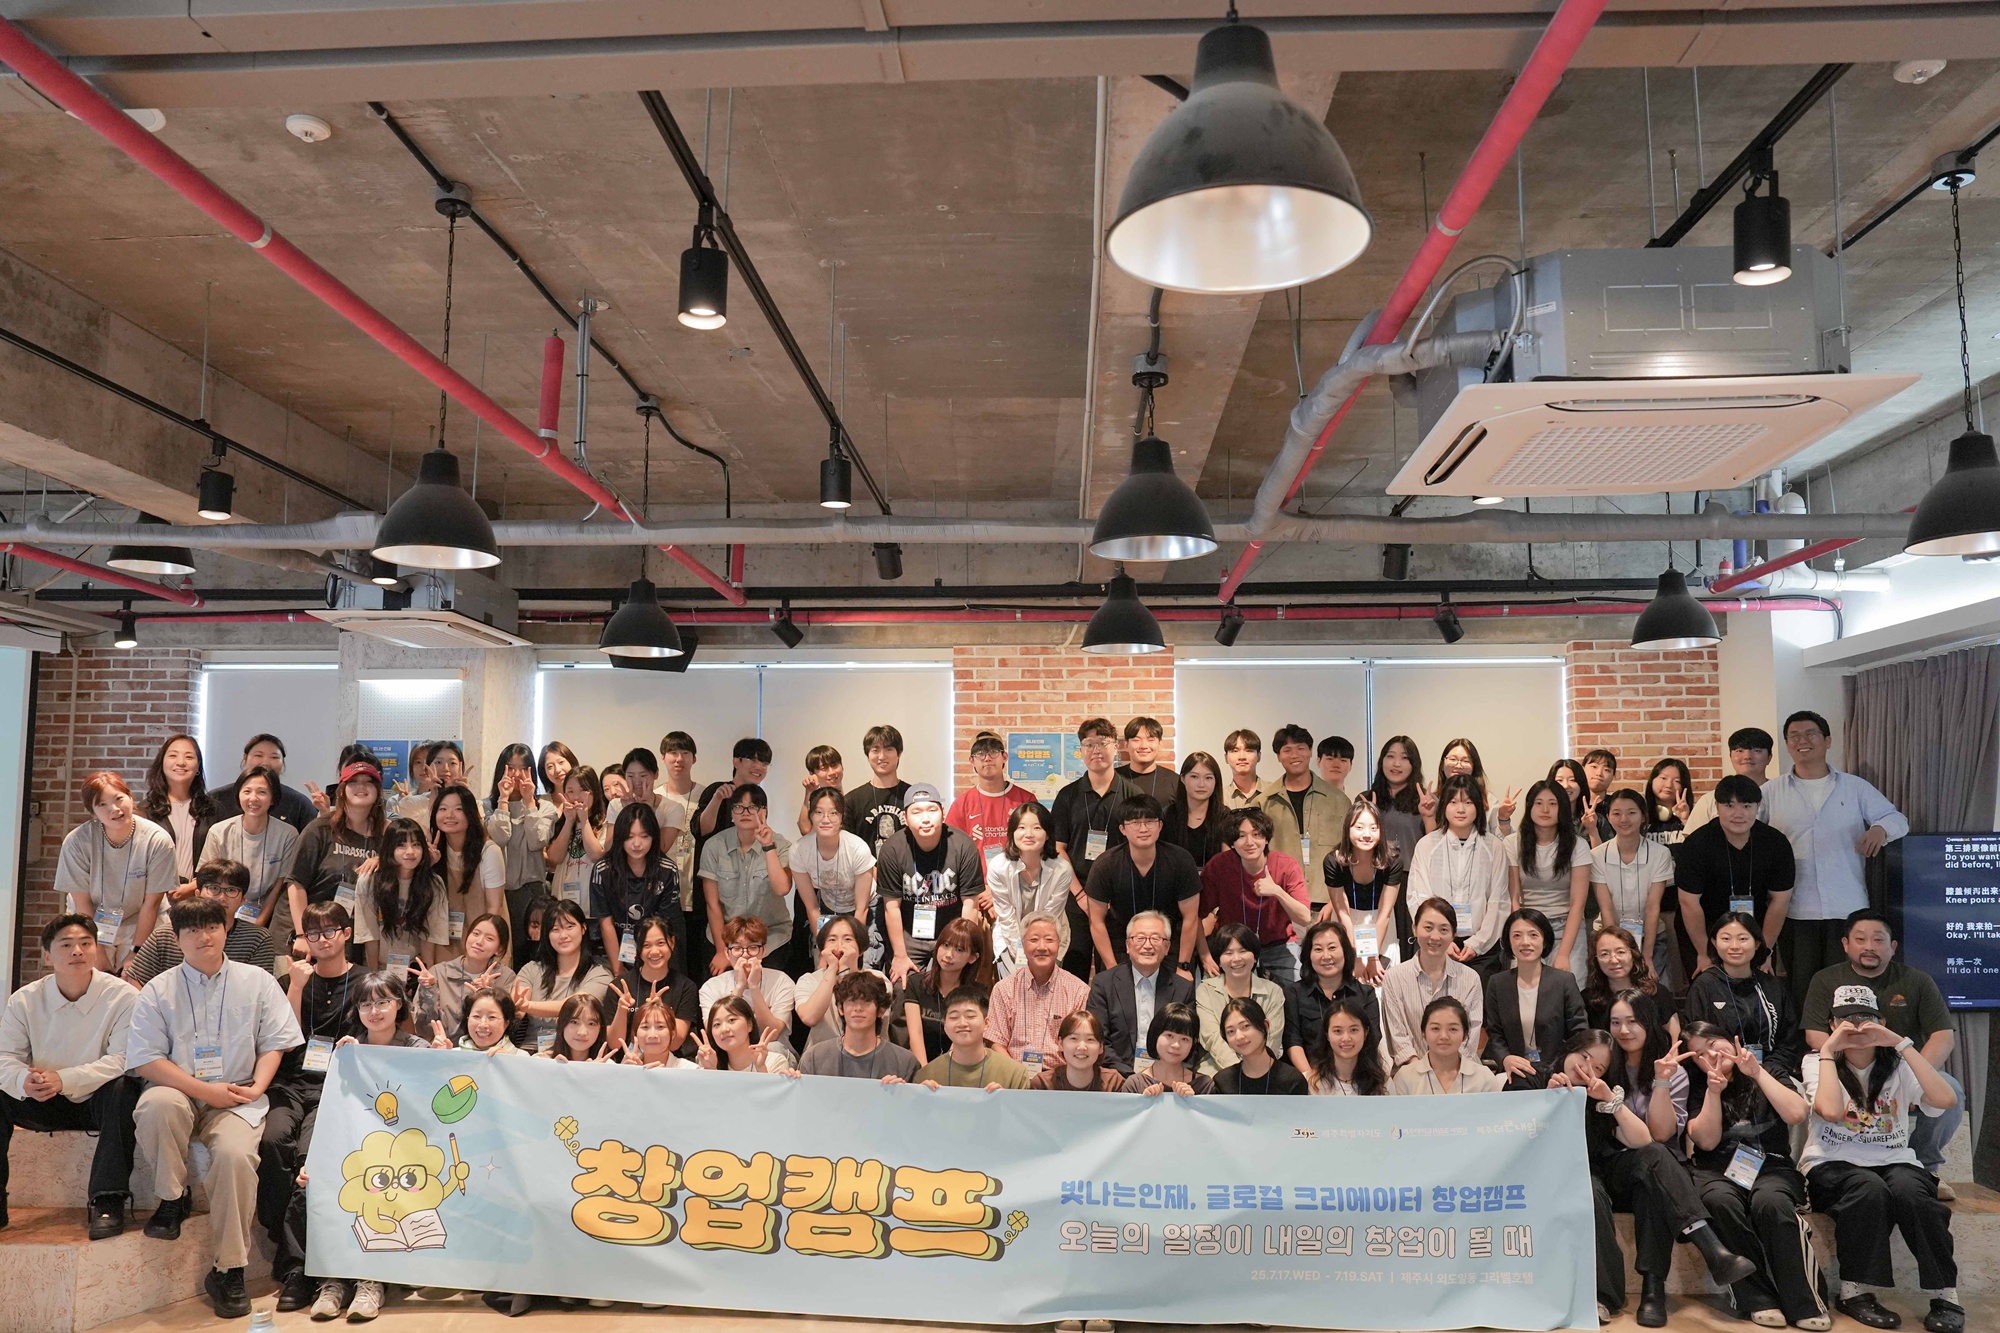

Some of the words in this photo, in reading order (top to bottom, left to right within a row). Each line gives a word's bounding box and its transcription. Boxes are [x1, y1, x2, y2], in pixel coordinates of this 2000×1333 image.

[333, 842, 370, 858] JURASSIC
[1945, 844, 2000, 852] 第三排要像前
[1962, 861, 1993, 869] before,
[1946, 922, 1963, 931] 好的
[1946, 932, 1971, 940] Okay.
[1946, 958, 1982, 966] 再来一次
[1291, 1127, 1319, 1139] Jeju
[571, 1139, 1004, 1262] 창업캠프
[1060, 1180, 1196, 1210] 빛나는인재,
[1207, 1184, 1284, 1210] 글로컬
[1294, 1186, 1423, 1212] 크리에이터
[1432, 1184, 1527, 1213] 창업캠프
[1059, 1220, 1150, 1255] 오늘의
[1163, 1223, 1253, 1256] 열정이
[1264, 1224, 1354, 1257] 내일의
[1365, 1224, 1457, 1259] 창업이
[1468, 1226, 1493, 1258] 될
[1503, 1224, 1534, 1258] 때
[1251, 1269, 1321, 1282] 25.7.17.WED
[1334, 1271, 1384, 1283] 7.19.SAT
[1400, 1272, 1433, 1285] 제주시
